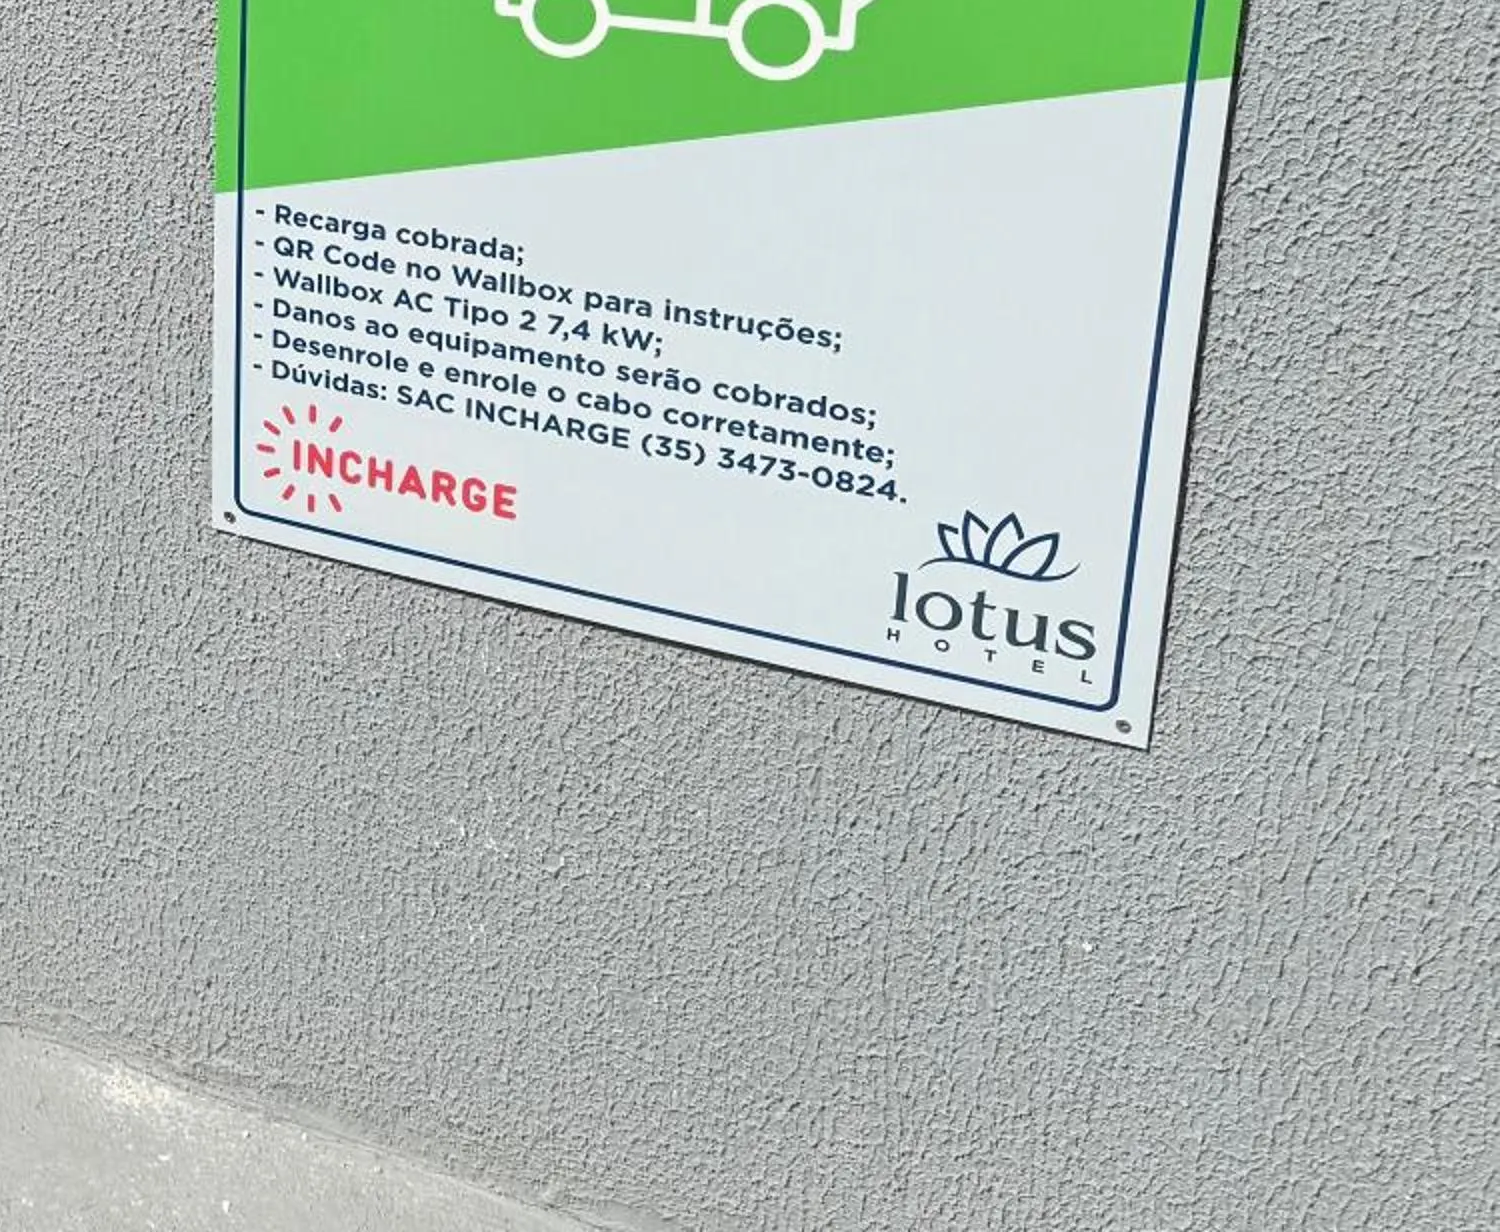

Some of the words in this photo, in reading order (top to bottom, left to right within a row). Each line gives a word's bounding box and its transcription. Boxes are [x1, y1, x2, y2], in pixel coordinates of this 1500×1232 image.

[275, 204, 386, 241] Recarga
[396, 227, 524, 267] cobrada;
[273, 236, 314, 261] QR
[323, 244, 396, 275] Code
[406, 261, 441, 282] no
[452, 265, 573, 305] Wallbox
[584, 291, 652, 318] para
[664, 298, 841, 353] instruções;
[273, 266, 383, 305] Wallbox
[393, 289, 433, 313] AC
[443, 296, 509, 326] Tipo
[519, 309, 536, 332] 2
[548, 314, 591, 341] 7,4
[602, 322, 663, 358] kW;
[273, 298, 356, 331] Danos
[365, 319, 399, 339] ao
[408, 327, 605, 377] equipamento
[616, 365, 701, 395] serão
[713, 383, 876, 431] cobrados;
[273, 329, 409, 373] Desenrole
[418, 361, 435, 378] e
[445, 366, 537, 398] enrole
[547, 386, 566, 403] o
[577, 391, 652, 419] cabo
[663, 407, 894, 470] corretamente;
[272, 359, 387, 401] Dúvidas:
[397, 385, 454, 413] SAC
[466, 398, 631, 449] INCHARGE
[641, 433, 706, 467] (35)
[717, 447, 907, 504] 3473-0824.
[293, 439, 517, 520] INCHARGE
[889, 570, 1097, 661] lotus
